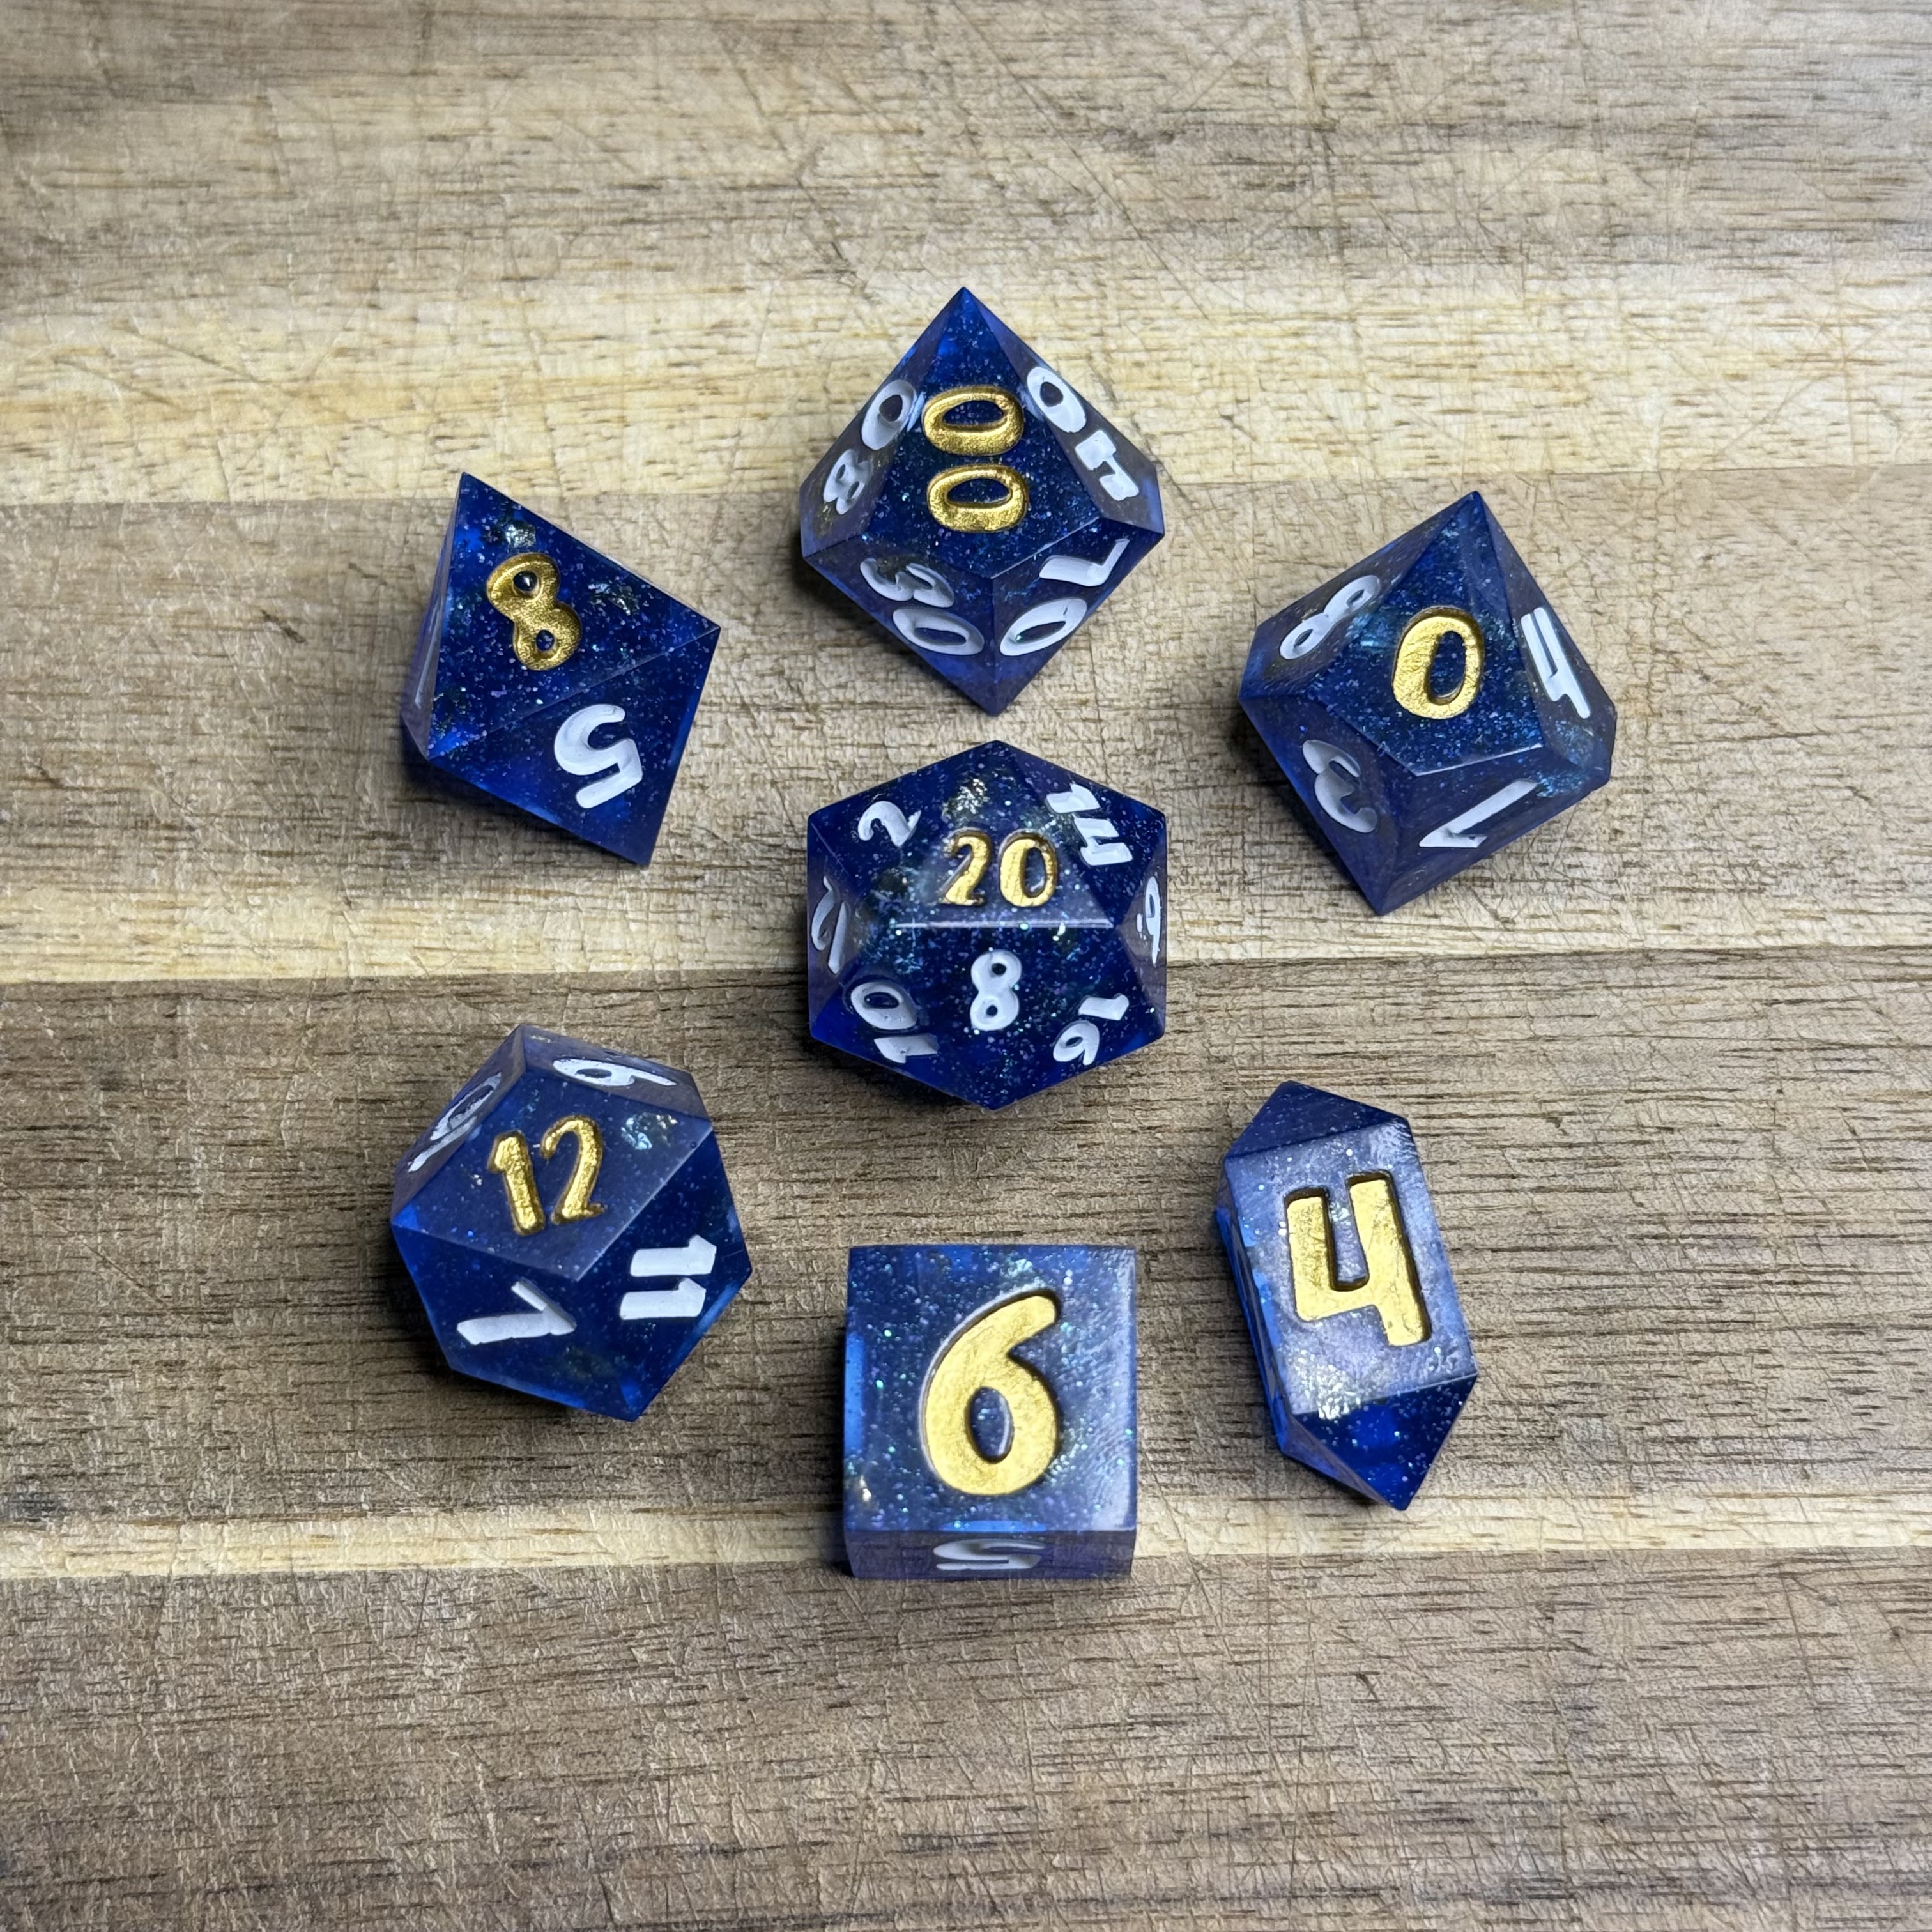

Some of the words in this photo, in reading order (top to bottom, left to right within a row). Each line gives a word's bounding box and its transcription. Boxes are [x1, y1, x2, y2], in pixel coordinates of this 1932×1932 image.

[921, 385, 1029, 534] 00
[486, 551, 582, 671] 8
[1278, 574, 1382, 660] 8
[1390, 604, 1485, 720] 0
[1519, 606, 1591, 719] 4
[554, 703, 643, 809] 5
[1301, 739, 1378, 833] 3
[858, 801, 921, 847] 2
[940, 829, 1059, 907] 20
[1046, 782, 1133, 866] 14
[970, 949, 1022, 1031] 8
[488, 1114, 608, 1237] 12
[618, 1235, 717, 1321] 11
[1283, 1169, 1432, 1347] 4
[919, 1289, 1062, 1496] 6
